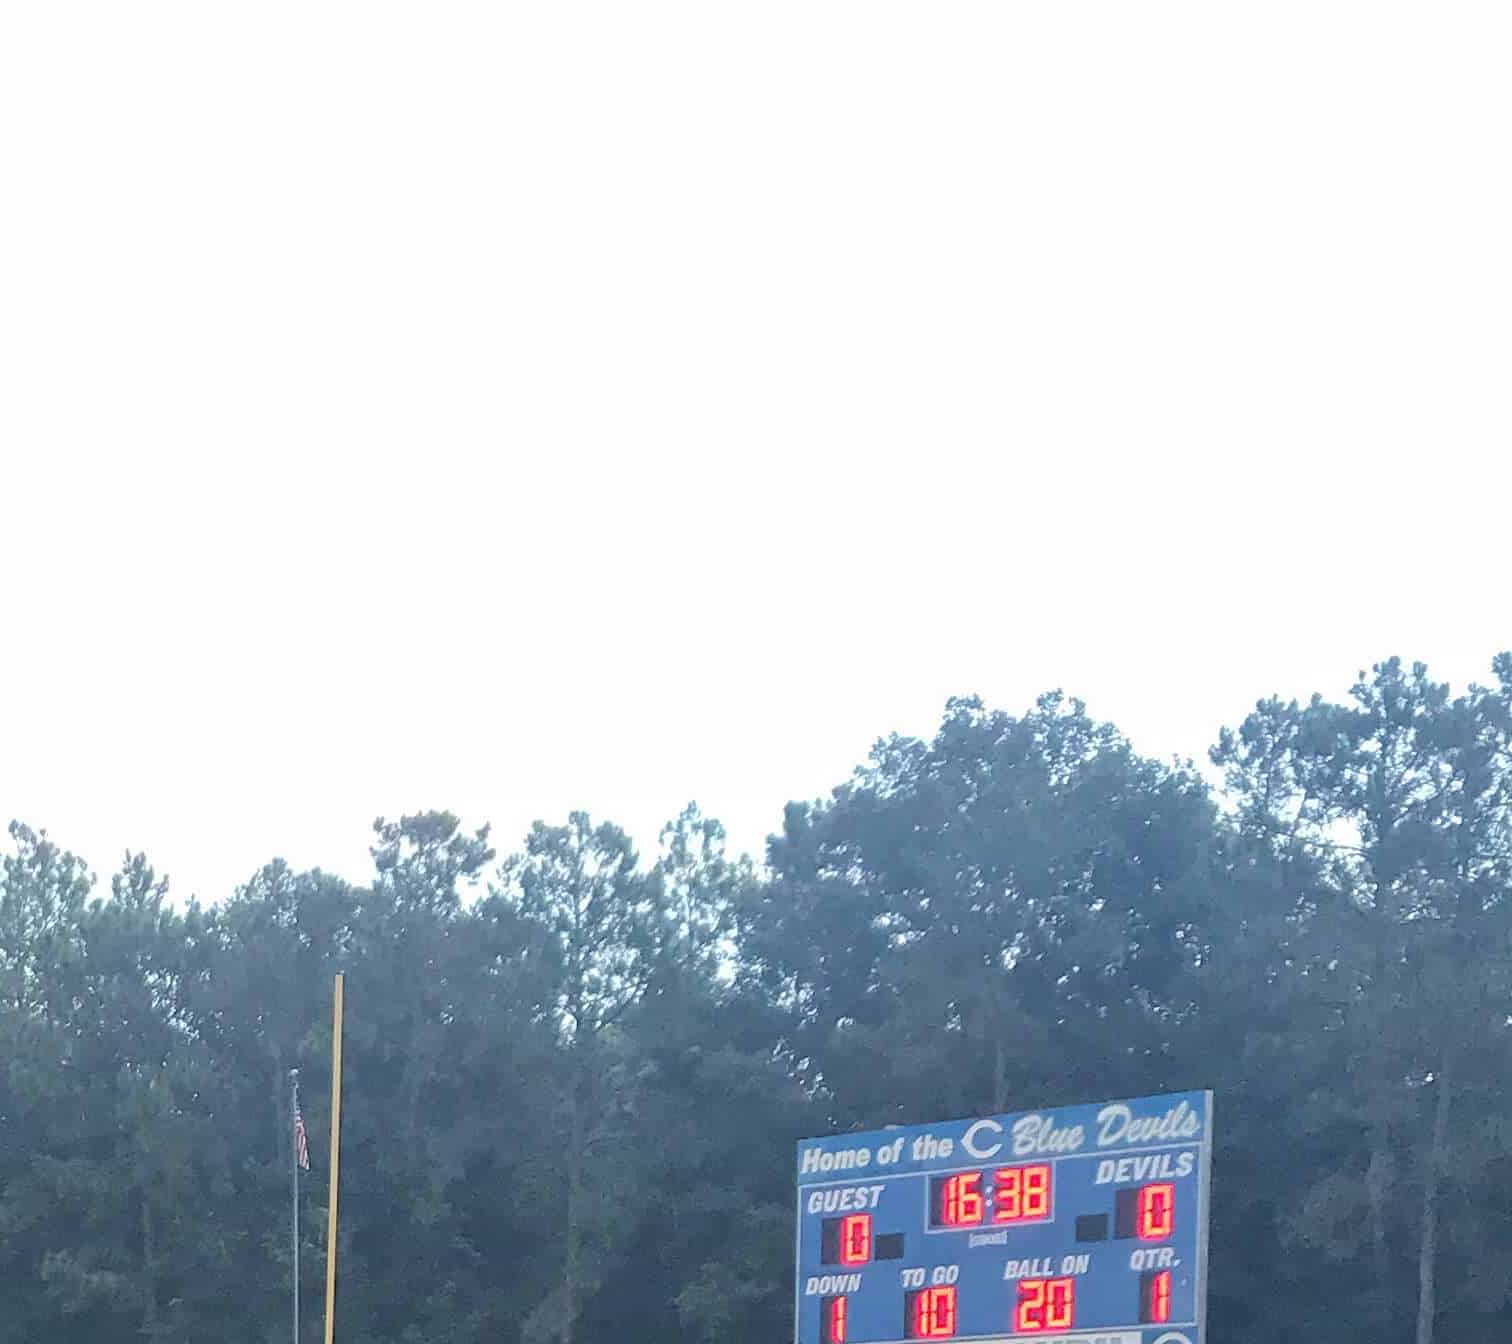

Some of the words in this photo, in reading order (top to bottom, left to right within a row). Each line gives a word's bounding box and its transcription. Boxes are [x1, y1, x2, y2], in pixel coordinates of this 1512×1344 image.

[801, 1148, 871, 1174] Home
[877, 1138, 904, 1165] of
[913, 1134, 953, 1160] the
[1011, 1115, 1085, 1156] Blue
[1096, 1101, 1200, 1146] Devils
[1095, 1152, 1194, 1185] DEVILS
[808, 1184, 887, 1214] GUEST
[943, 1165, 1050, 1226] 16:38
[1141, 1184, 1174, 1239] 0
[844, 1214, 871, 1264] 0
[1130, 1248, 1181, 1271] QTR.
[805, 1274, 862, 1295] DOWN
[902, 1268, 925, 1288] TO
[932, 1265, 959, 1285] GO
[1004, 1259, 1055, 1280] BALL
[1061, 1255, 1090, 1275] ON
[833, 1296, 846, 1344] 1
[917, 1287, 956, 1338] 10
[1015, 1278, 1074, 1331] 20
[1154, 1271, 1170, 1323] 1
